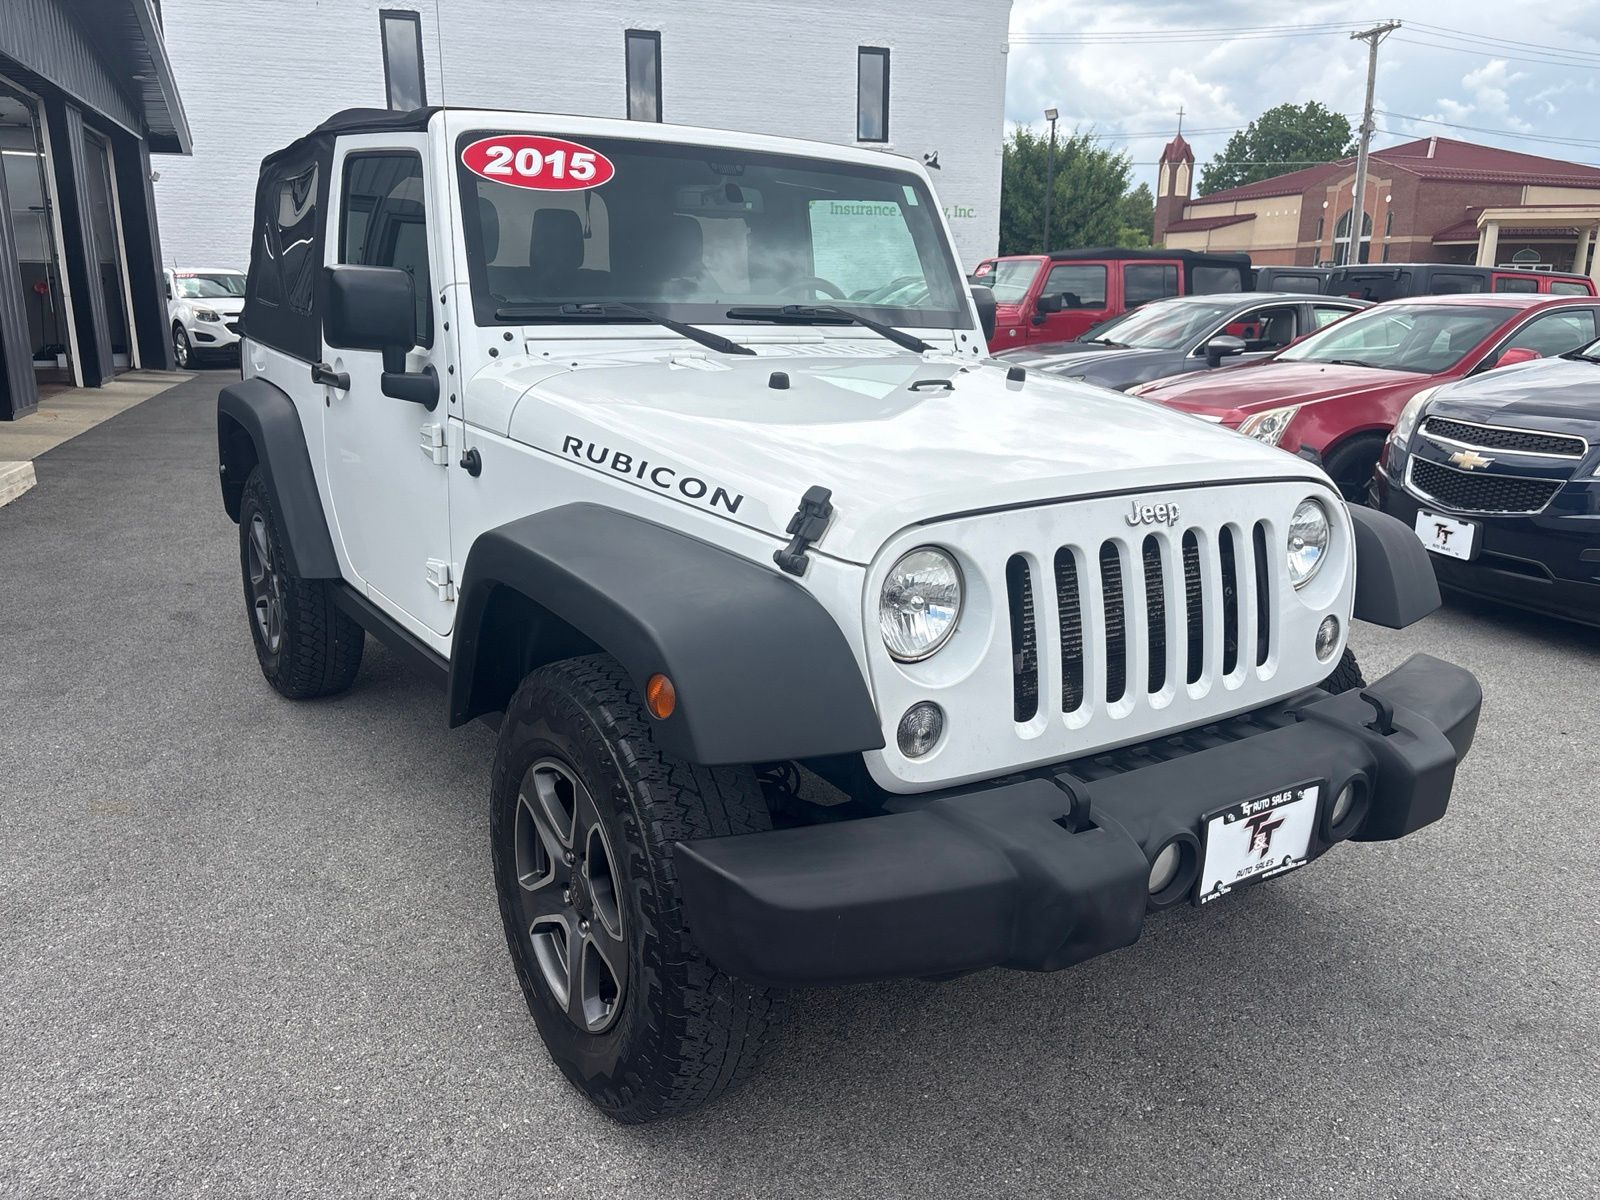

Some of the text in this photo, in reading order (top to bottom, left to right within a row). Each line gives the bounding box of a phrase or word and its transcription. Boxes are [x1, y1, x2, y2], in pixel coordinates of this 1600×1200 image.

[483, 146, 597, 181] 2015
[830, 202, 896, 216] Insurance
[954, 205, 977, 218] Inc.
[562, 435, 745, 514] RUBICON
[1125, 500, 1180, 527] Jeep
[1253, 799, 1269, 812] AUTO
[1271, 791, 1292, 806] SALES
[1236, 866, 1252, 878] AUTO
[1254, 858, 1274, 871] SALES
